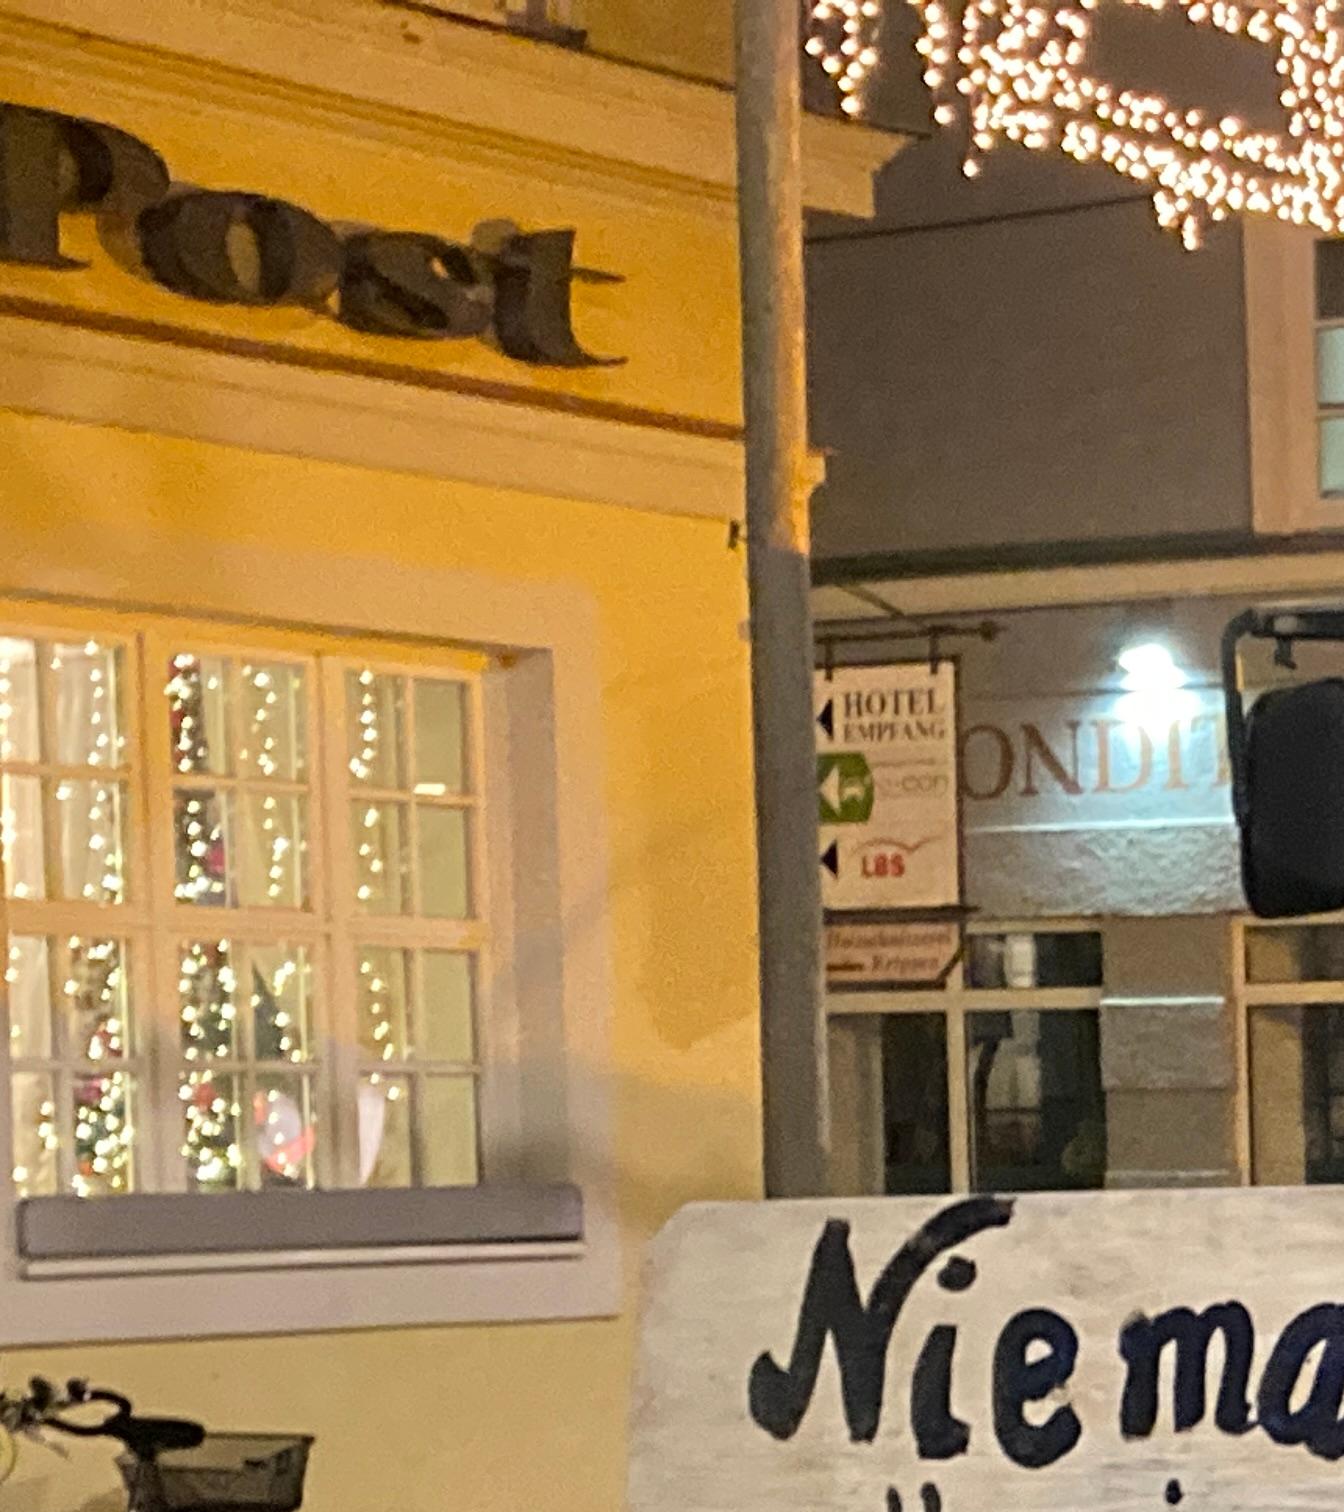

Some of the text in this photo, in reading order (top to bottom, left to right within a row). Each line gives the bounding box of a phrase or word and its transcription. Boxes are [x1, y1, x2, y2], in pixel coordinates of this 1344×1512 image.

[0, 103, 627, 368] Post
[843, 687, 945, 719] HOTEL
[843, 719, 945, 744] EMPFANG
